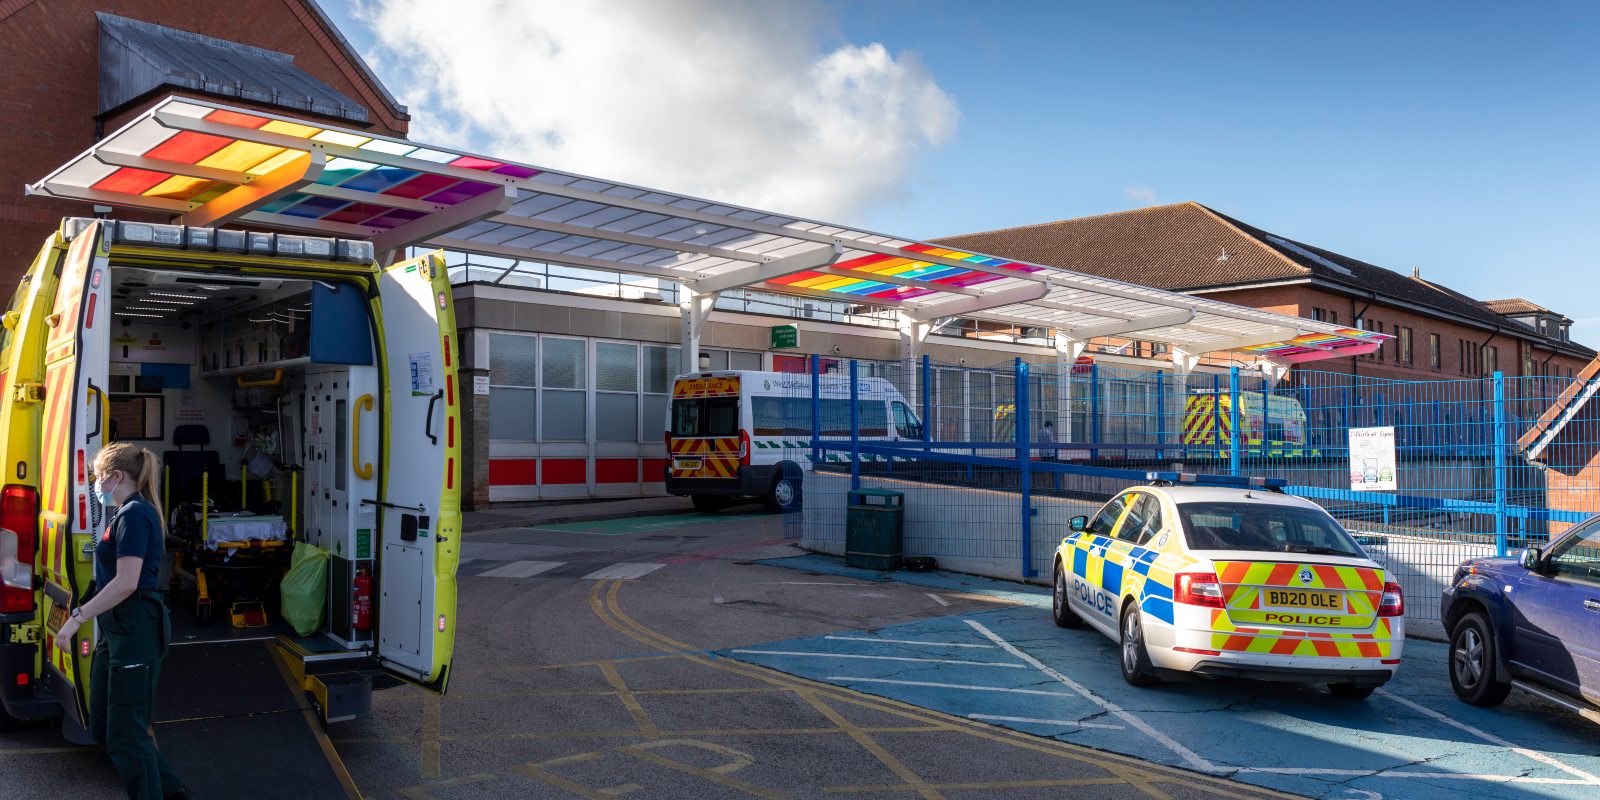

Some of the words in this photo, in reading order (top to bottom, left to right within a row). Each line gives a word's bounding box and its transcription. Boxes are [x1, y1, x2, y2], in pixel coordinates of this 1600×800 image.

[1075, 579, 1113, 617] POLICE
[1270, 592, 1307, 606] BD20
[1311, 594, 1338, 608] OLE
[1265, 613, 1342, 626] POLICE
